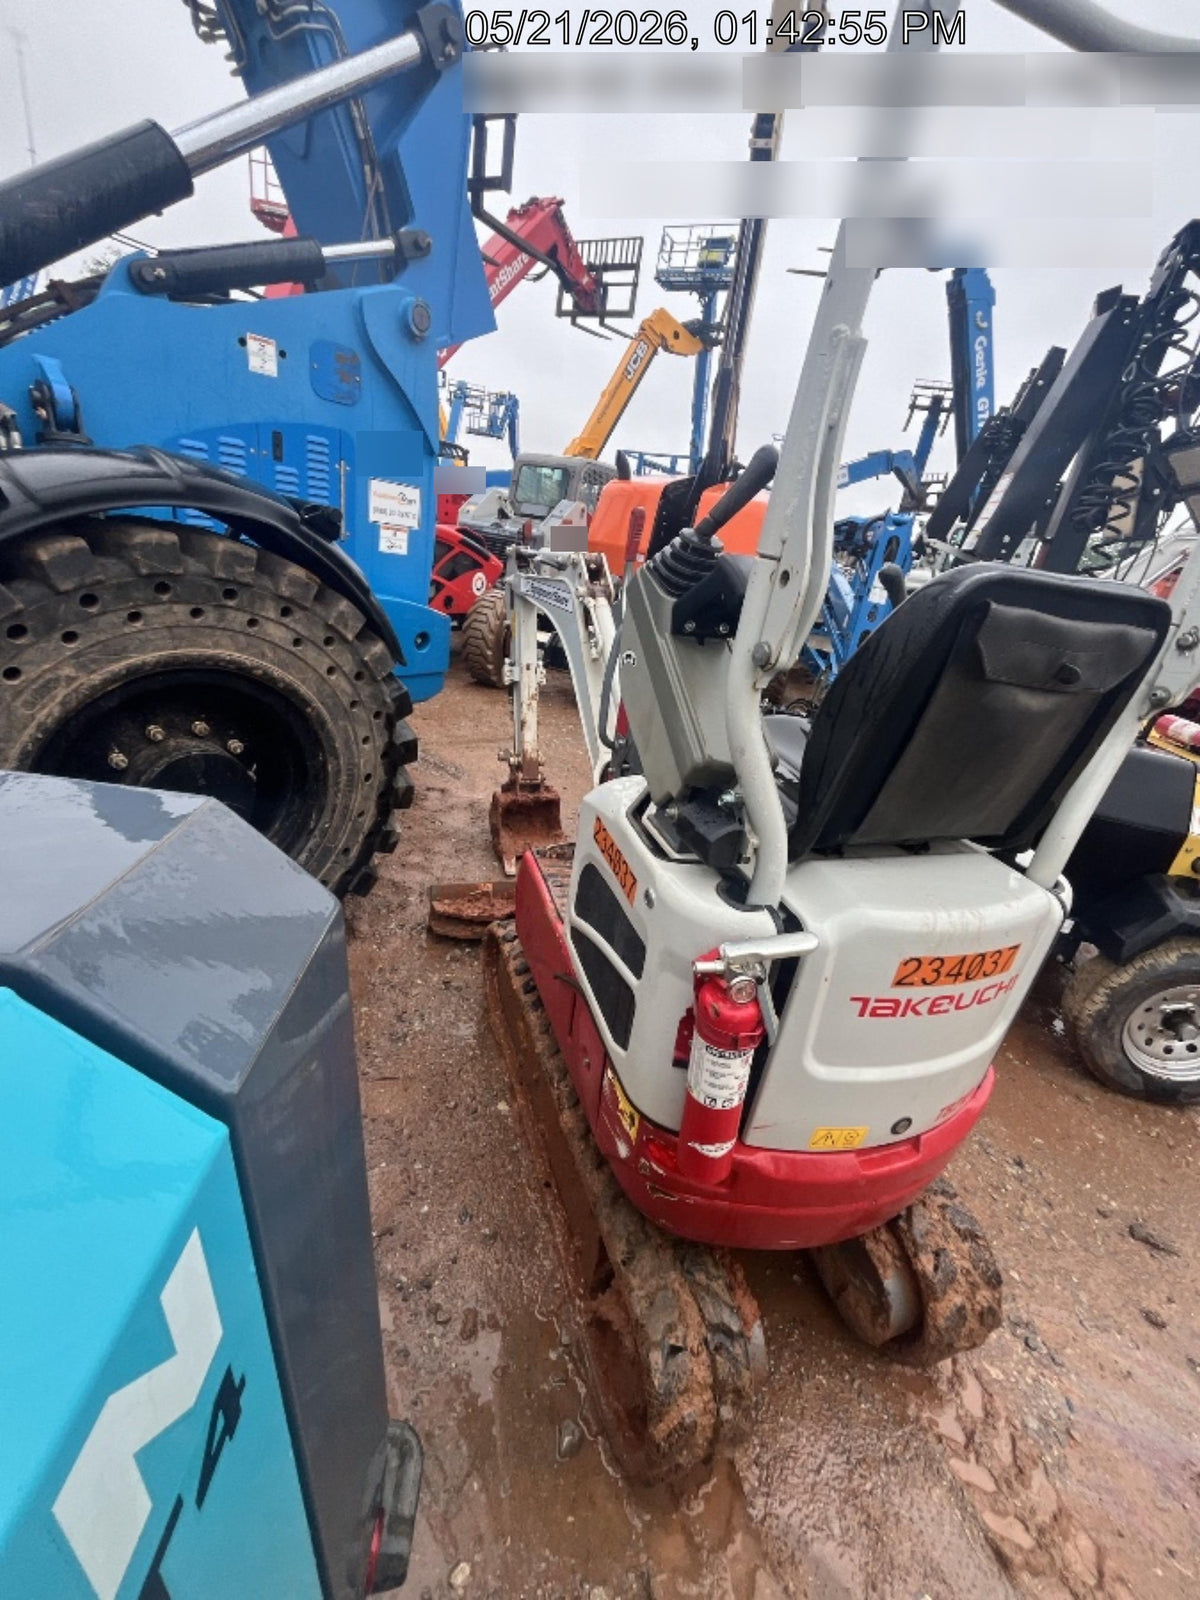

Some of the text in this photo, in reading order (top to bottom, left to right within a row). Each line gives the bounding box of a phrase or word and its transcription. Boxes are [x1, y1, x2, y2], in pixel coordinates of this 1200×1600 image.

[489, 252, 530, 299] ntShare
[624, 340, 648, 381] JCB
[975, 335, 988, 391] Genie
[894, 943, 1022, 987] 234037
